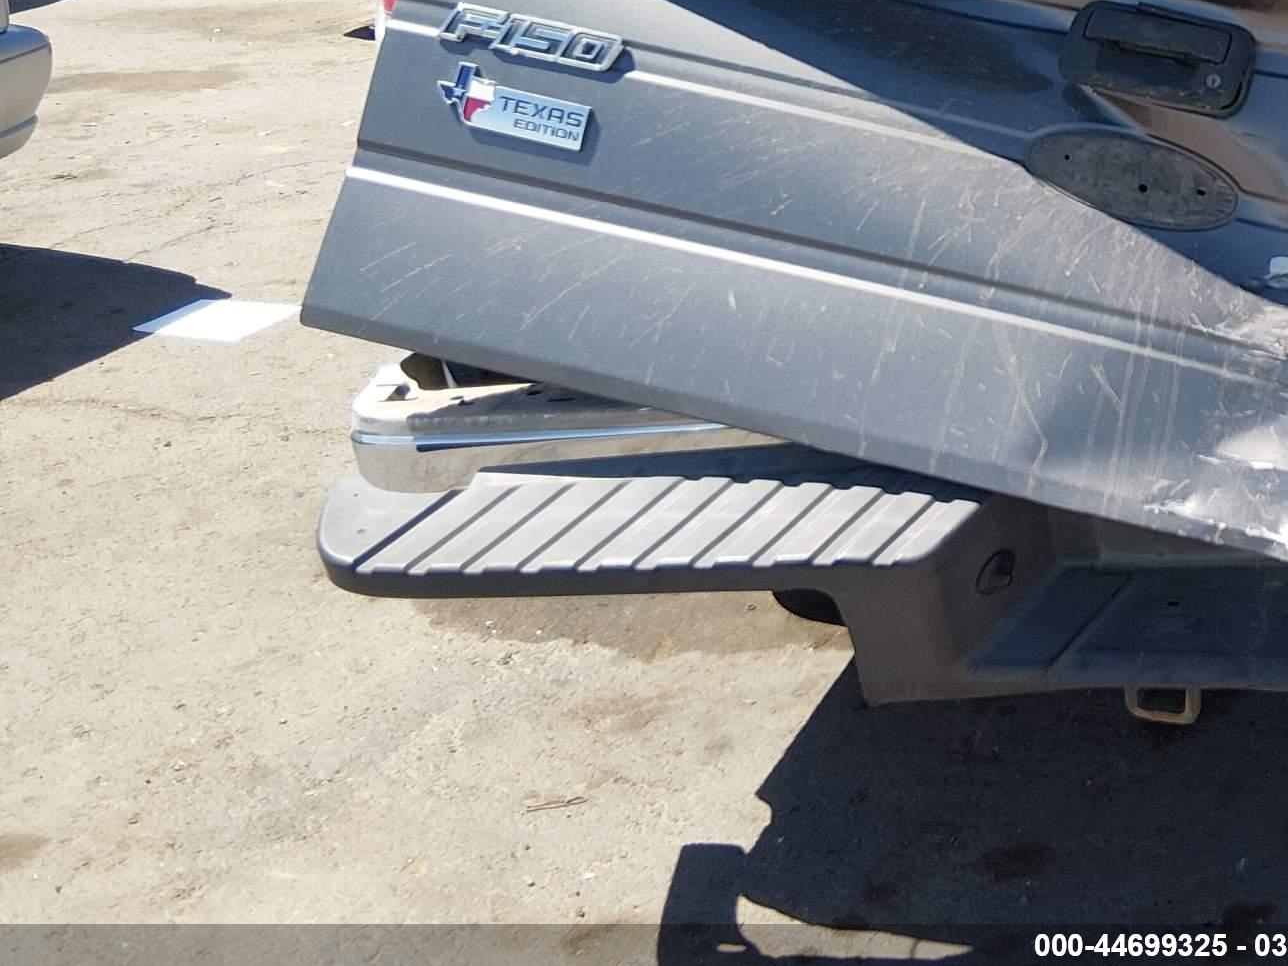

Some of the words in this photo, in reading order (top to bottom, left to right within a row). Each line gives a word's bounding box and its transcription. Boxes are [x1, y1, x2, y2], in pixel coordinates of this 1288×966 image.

[438, 1, 625, 72] F-150
[500, 95, 585, 128] TEXAS
[513, 119, 580, 142] EDITION
